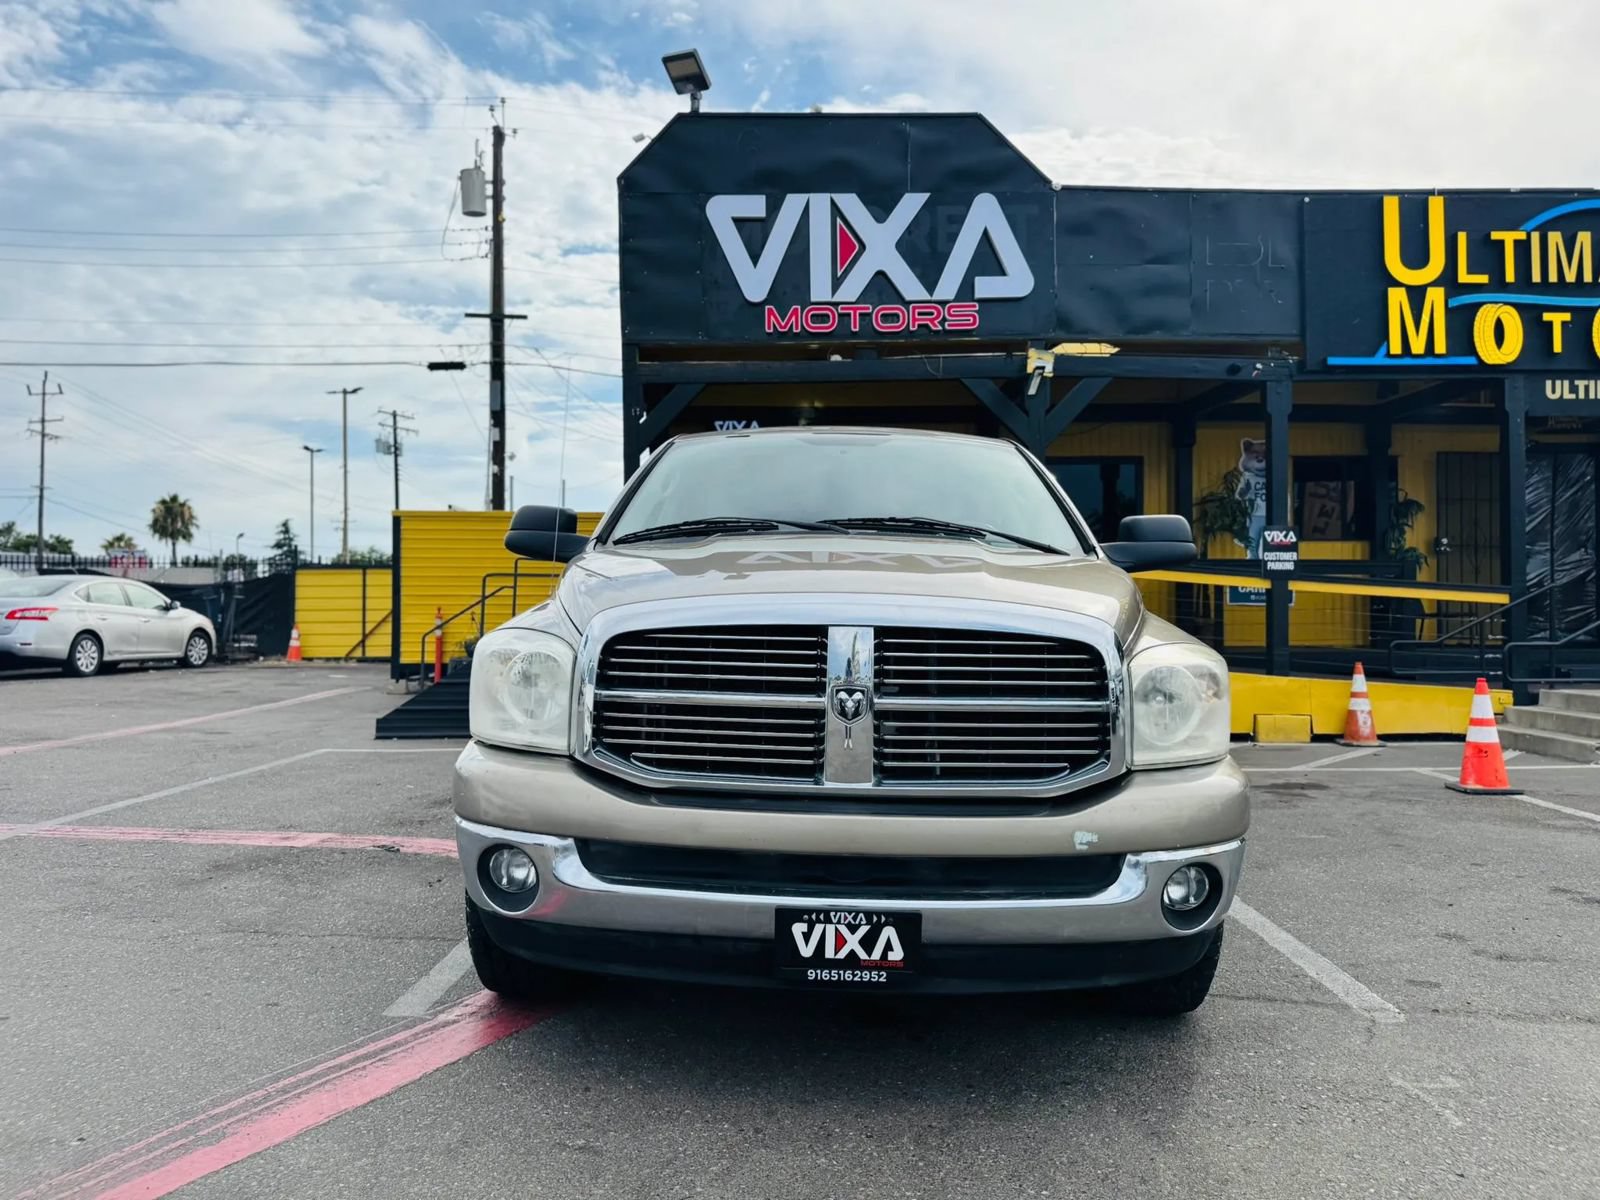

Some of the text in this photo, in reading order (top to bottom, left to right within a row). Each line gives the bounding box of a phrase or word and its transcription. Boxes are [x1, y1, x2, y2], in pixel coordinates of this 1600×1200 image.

[705, 192, 1035, 304] VIXA
[1382, 194, 1600, 286] ULTIM
[764, 302, 980, 334] MOTORS
[1386, 286, 1600, 366] MOT
[1544, 379, 1600, 400] ULTI
[1263, 530, 1297, 543] VIXA
[1263, 551, 1298, 561] CUSTOMER
[1266, 561, 1295, 571] PARKING
[829, 911, 867, 925] VIXA
[791, 922, 905, 961] VIXA
[860, 959, 904, 968] MOTORS
[807, 969, 887, 982] 9165162952
